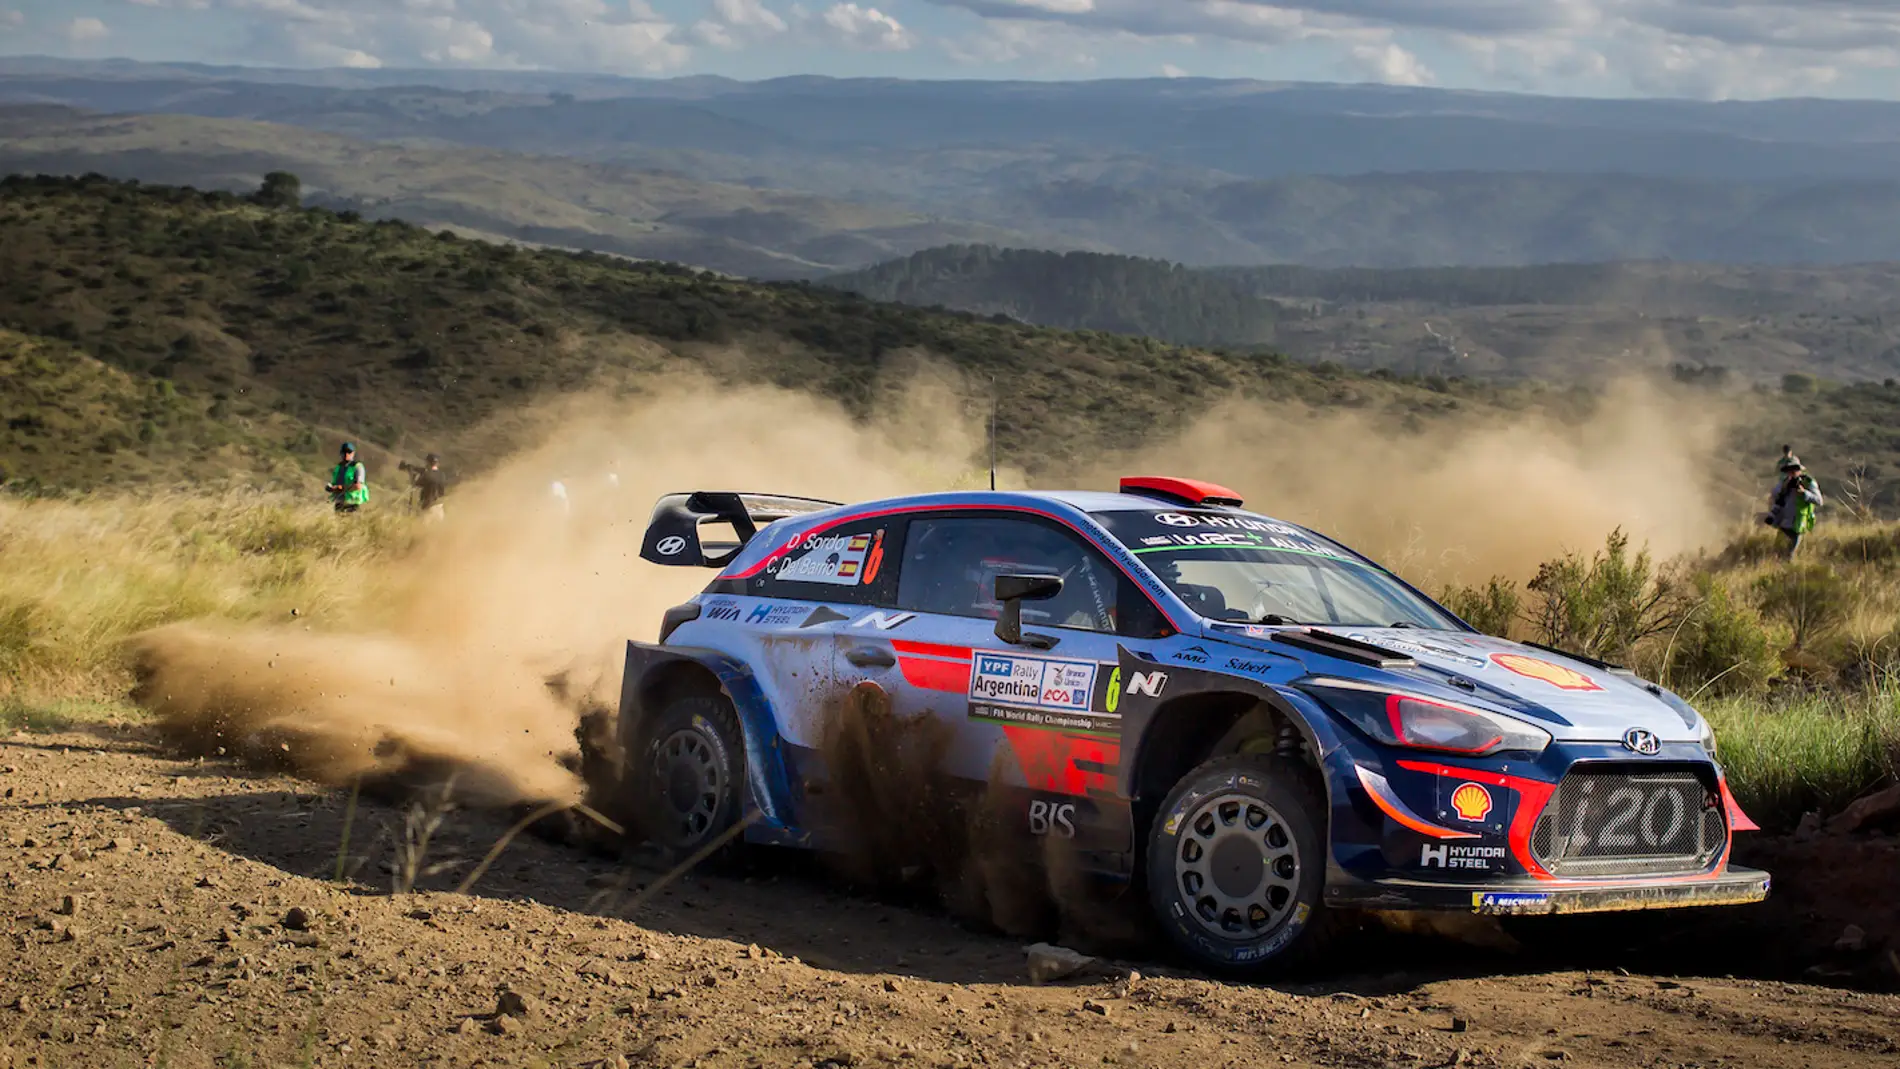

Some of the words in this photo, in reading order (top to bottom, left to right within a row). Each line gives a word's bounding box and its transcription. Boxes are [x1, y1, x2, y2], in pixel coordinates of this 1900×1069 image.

[786, 532, 800, 550] D.
[803, 533, 845, 551] Sordo
[766, 556, 778, 574] C.
[799, 557, 836, 577] Barrio
[1081, 519, 1166, 598] motorsport.hyundai.com
[706, 606, 742, 621] WIA
[982, 660, 1010, 673] YPF
[1013, 664, 1039, 681] Rally
[974, 674, 1040, 697] Argentina
[1105, 666, 1121, 713] 6
[993, 709, 1005, 718] FIA
[1005, 710, 1026, 721] World
[1026, 712, 1044, 725] Rally
[1044, 714, 1093, 729] Championship
[1029, 799, 1076, 838] BIS
[1569, 780, 1684, 847] i20
[1449, 846, 1506, 858] HYUNDAI
[1448, 858, 1490, 869] STEEL
